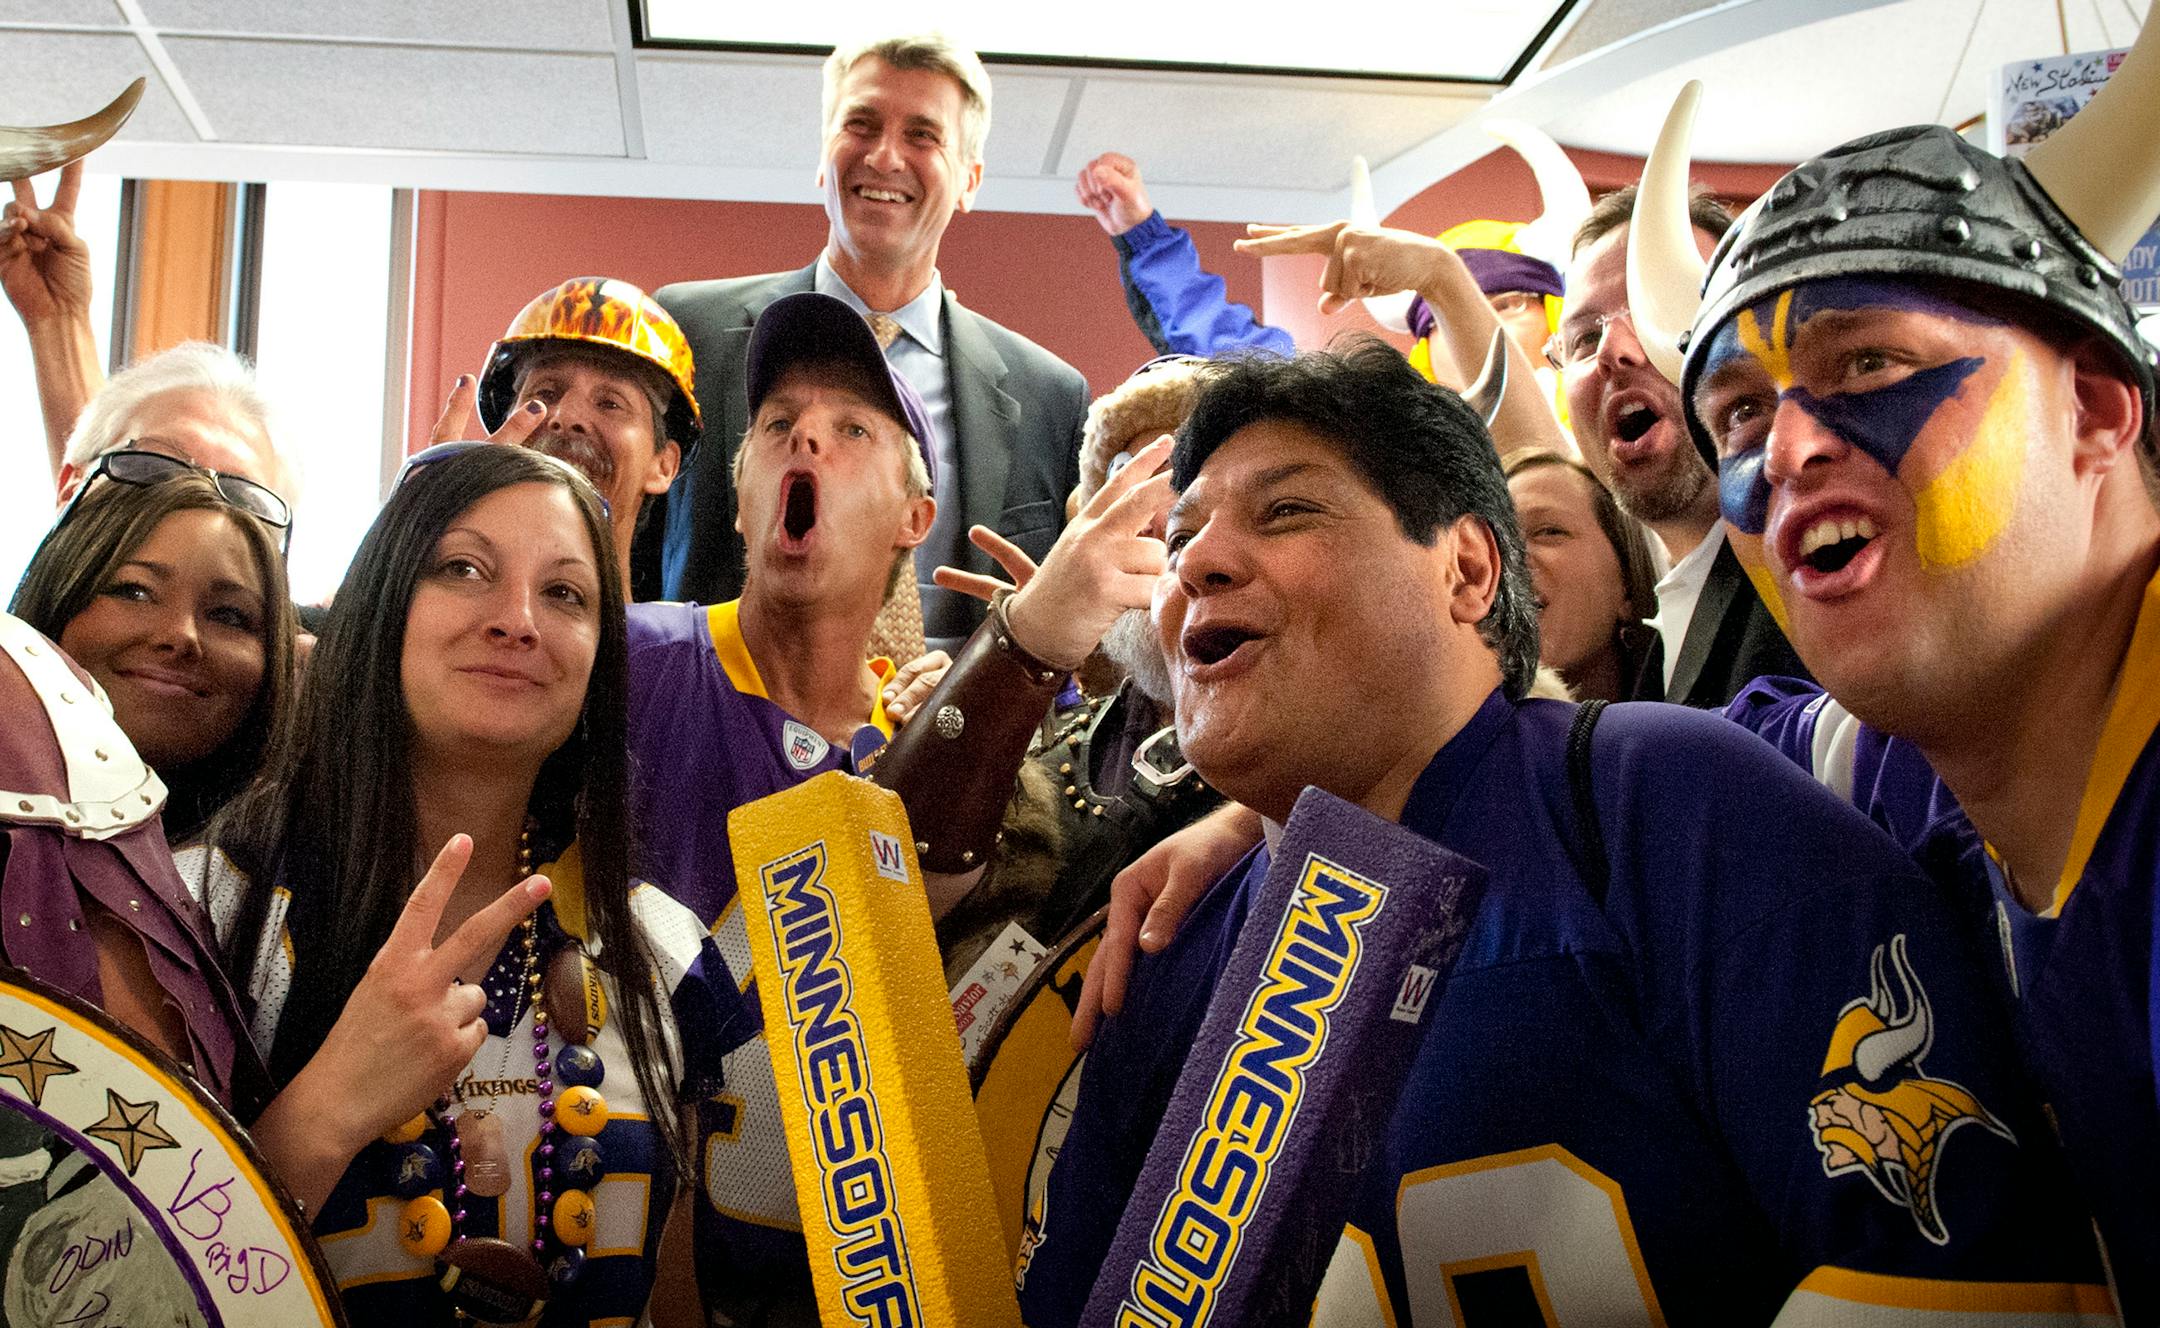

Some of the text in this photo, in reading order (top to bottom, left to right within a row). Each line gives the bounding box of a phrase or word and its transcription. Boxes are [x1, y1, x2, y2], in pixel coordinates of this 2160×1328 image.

[2121, 246, 2158, 271] ADY
[792, 744, 810, 762] NFL
[872, 834, 900, 870] W
[1114, 852, 1390, 1328] MINNESOT
